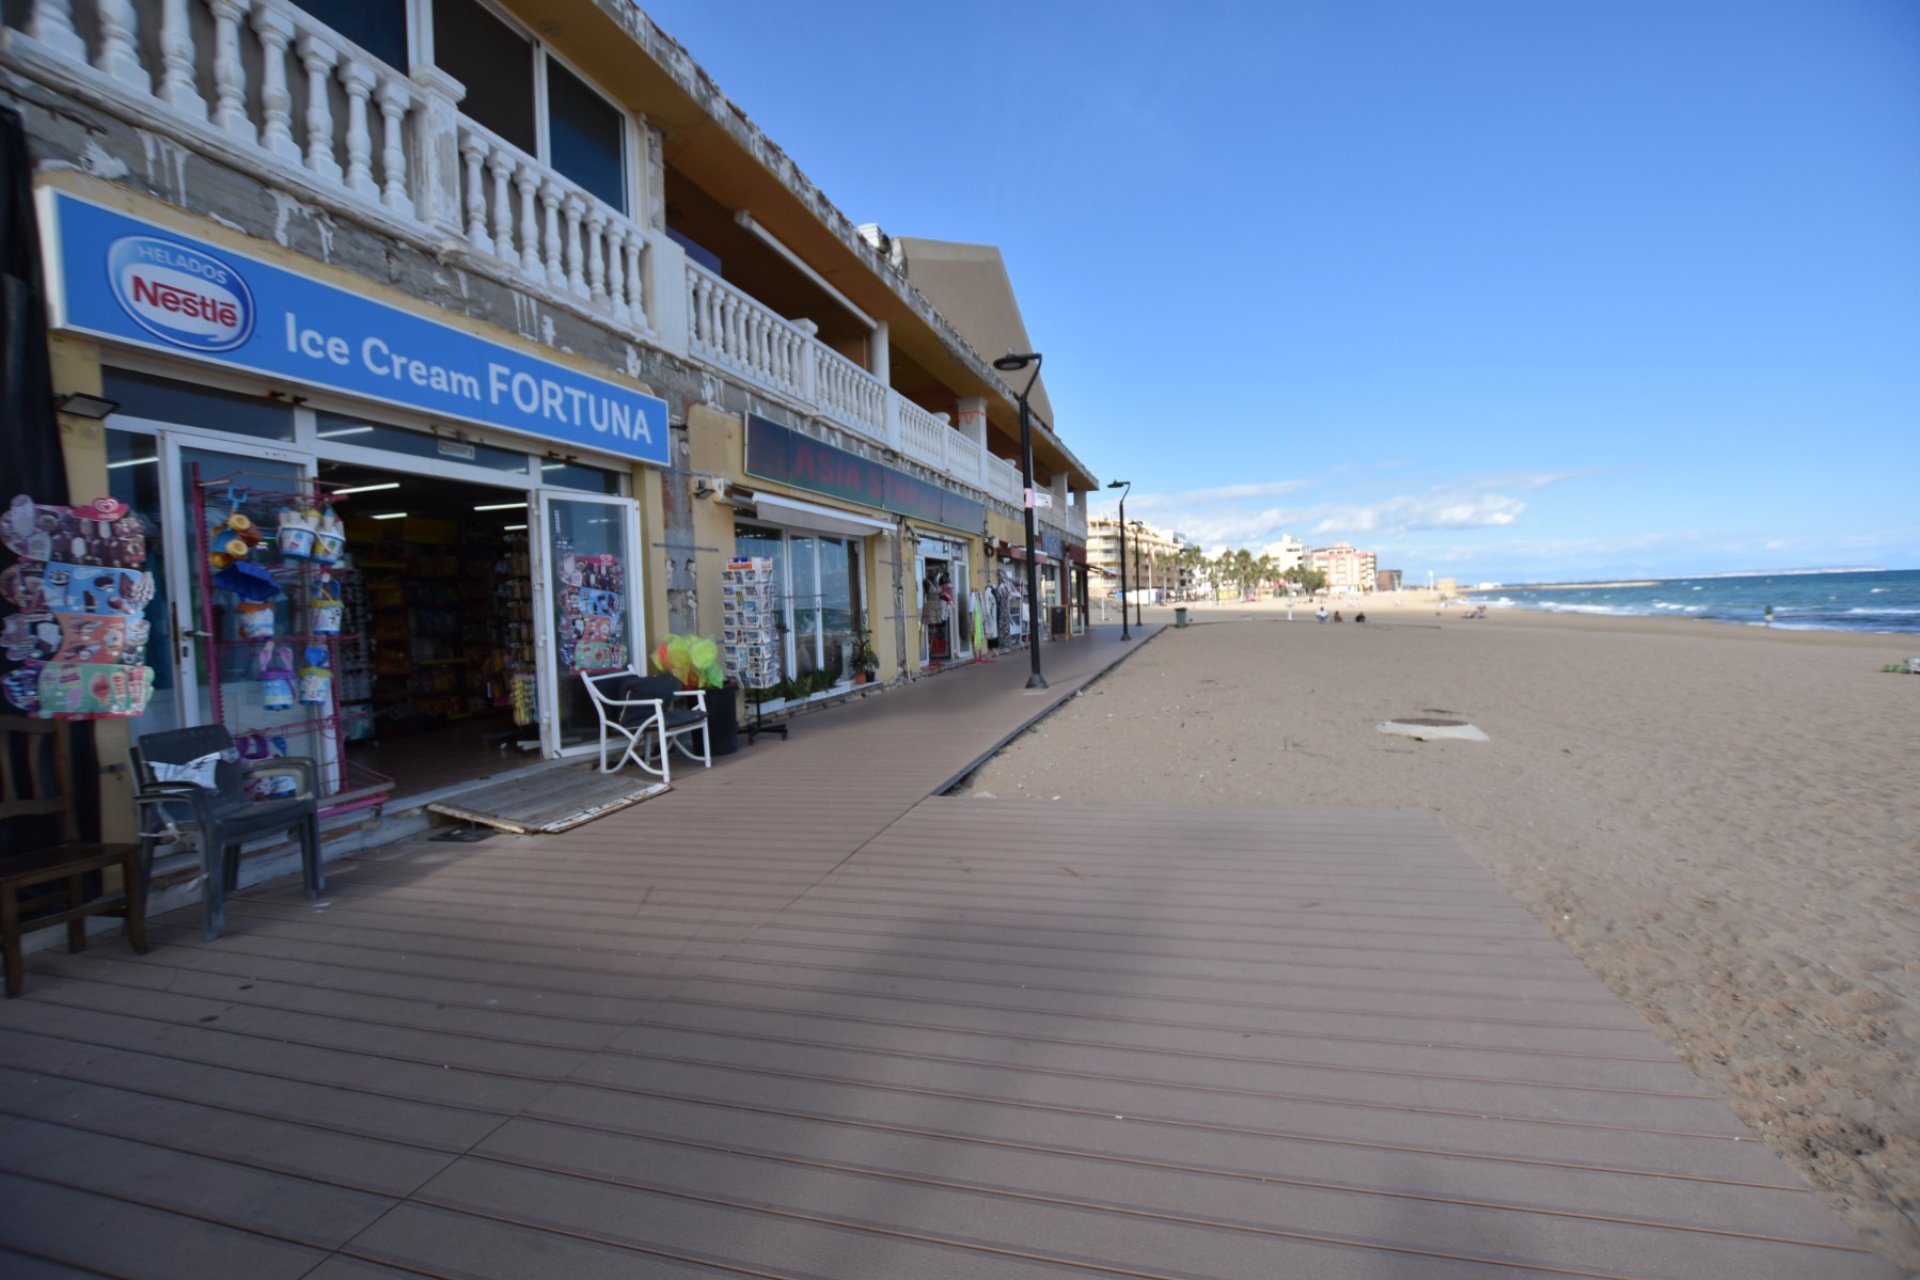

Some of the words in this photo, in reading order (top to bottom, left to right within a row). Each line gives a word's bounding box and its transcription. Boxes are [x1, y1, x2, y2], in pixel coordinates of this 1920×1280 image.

[138, 245, 228, 284] HELADOS
[285, 311, 350, 366] Ice
[361, 336, 481, 401] Cream
[488, 362, 653, 445] FORTUNA
[794, 444, 861, 493] ASIA
